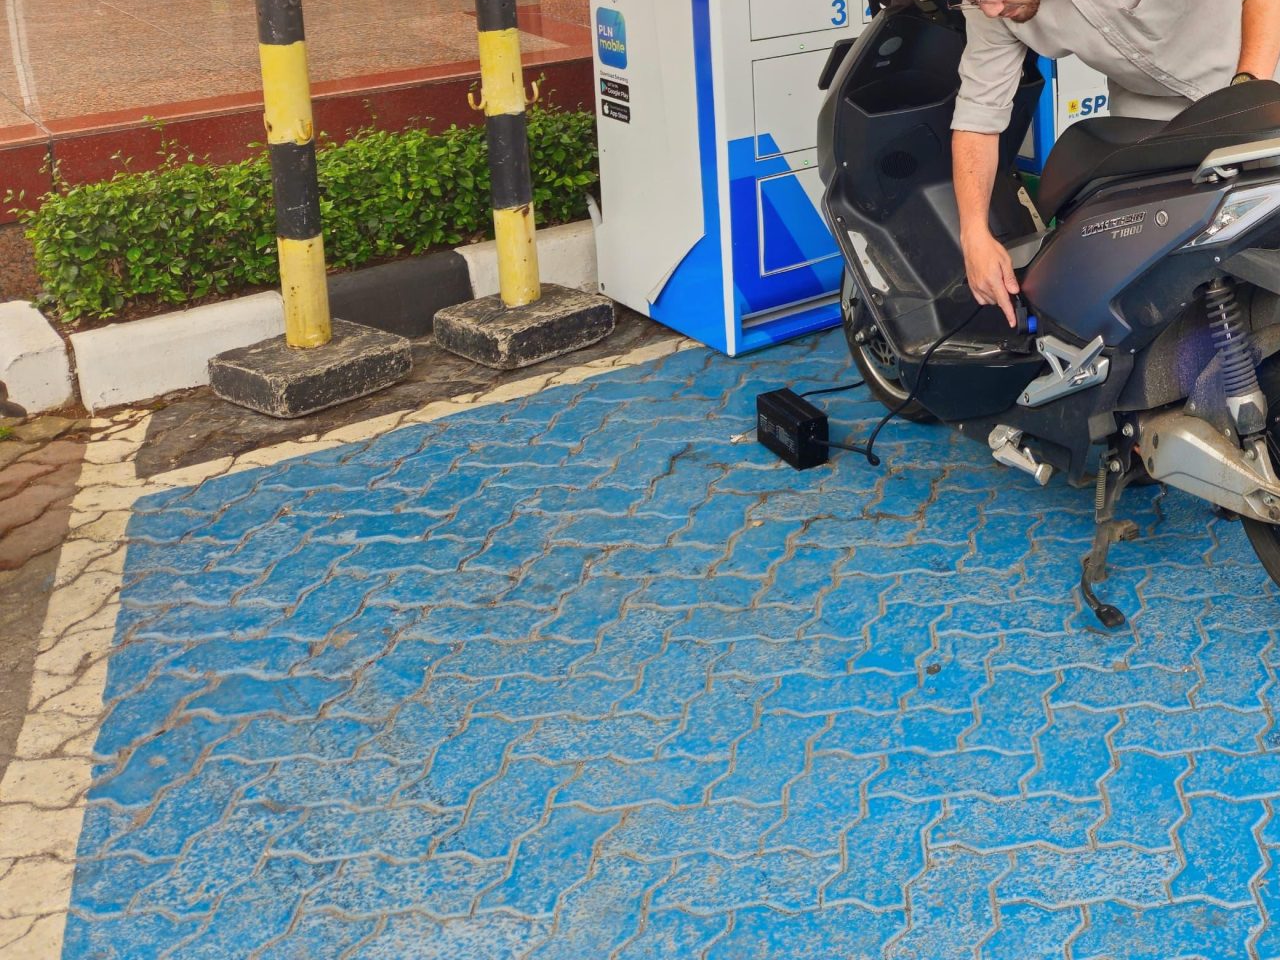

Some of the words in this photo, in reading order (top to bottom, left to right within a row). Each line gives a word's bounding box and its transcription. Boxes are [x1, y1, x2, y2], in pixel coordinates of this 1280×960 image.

[598, 24, 613, 37] PLN
[599, 38, 625, 54] mobile
[1111, 225, 1143, 239] T1800
